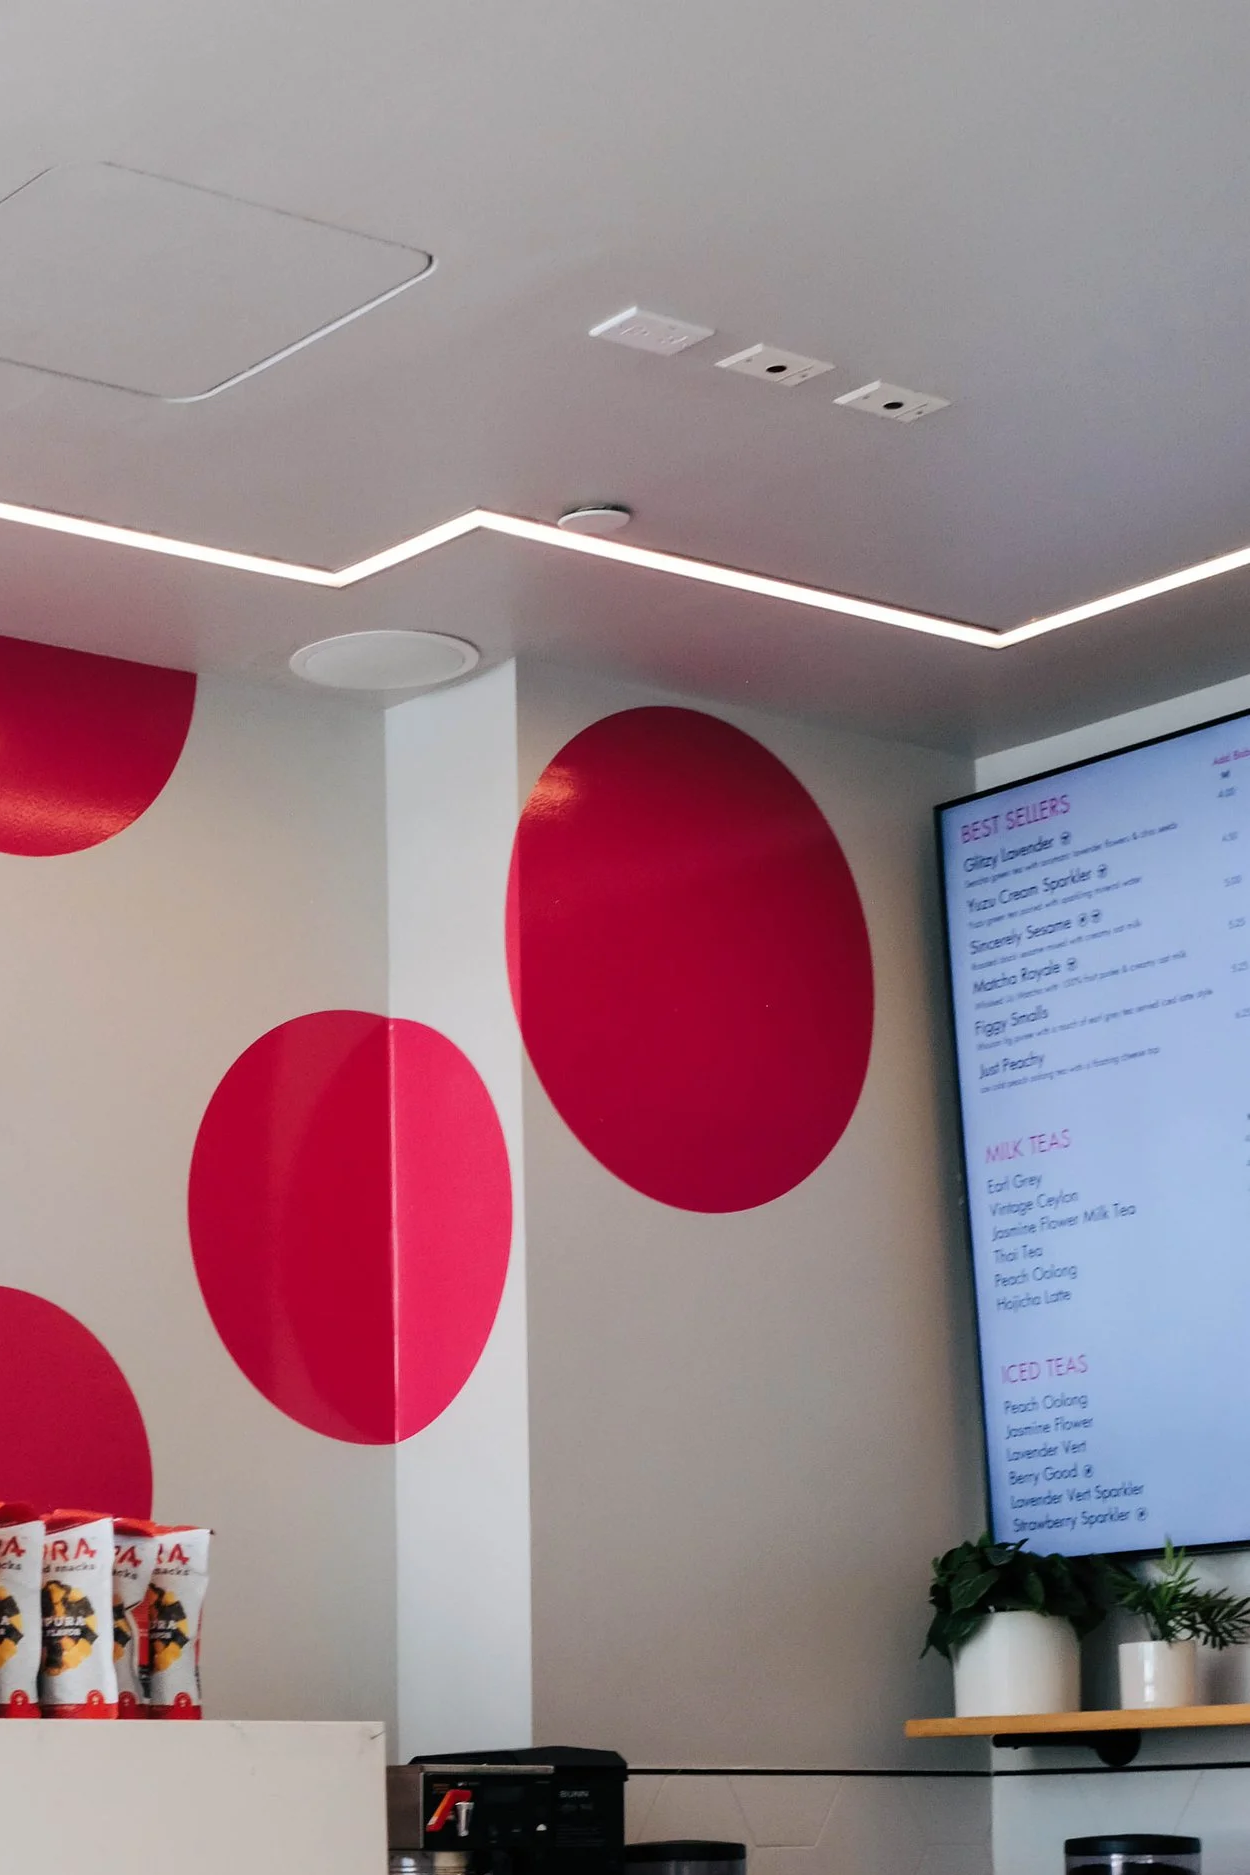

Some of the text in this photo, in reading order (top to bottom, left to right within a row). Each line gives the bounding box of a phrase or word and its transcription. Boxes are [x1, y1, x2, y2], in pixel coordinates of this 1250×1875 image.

[961, 794, 1071, 844] BEST SELLERS
[1000, 836, 1055, 862] Lavender
[966, 867, 1092, 913] Yuzu Cream Sparkler
[970, 919, 1072, 955] Sincerely Sesame
[972, 959, 1061, 994] Matcha Royale
[974, 1020, 1008, 1037] Figgy
[1011, 1004, 1049, 1027] Smalls
[978, 1051, 1046, 1080] Just Peachy
[985, 1128, 1072, 1163] MILK TEAS
[986, 1173, 1043, 1194] Earl Grey
[988, 1188, 1079, 1217] Vintage Ceylon
[991, 1202, 1137, 1242] Jasmine Flower Milk Tea
[992, 1244, 1043, 1263] Thai Tea
[994, 1263, 1078, 1287] Peach Oolong
[997, 1289, 1072, 1313] Hojicha Latte
[1001, 1354, 1089, 1384] ICED TEAS
[1004, 1390, 1089, 1415] Peach Oolong
[1005, 1416, 1094, 1440] Jasmine Flower
[1006, 1440, 1087, 1462] Lavender Vert
[1008, 1462, 1078, 1486] Berry Good
[1010, 1480, 1144, 1509] Lavender Vert Sparkler
[1013, 1507, 1130, 1532] Strawberry Sparkler
[112, 1568, 138, 1580] acks
